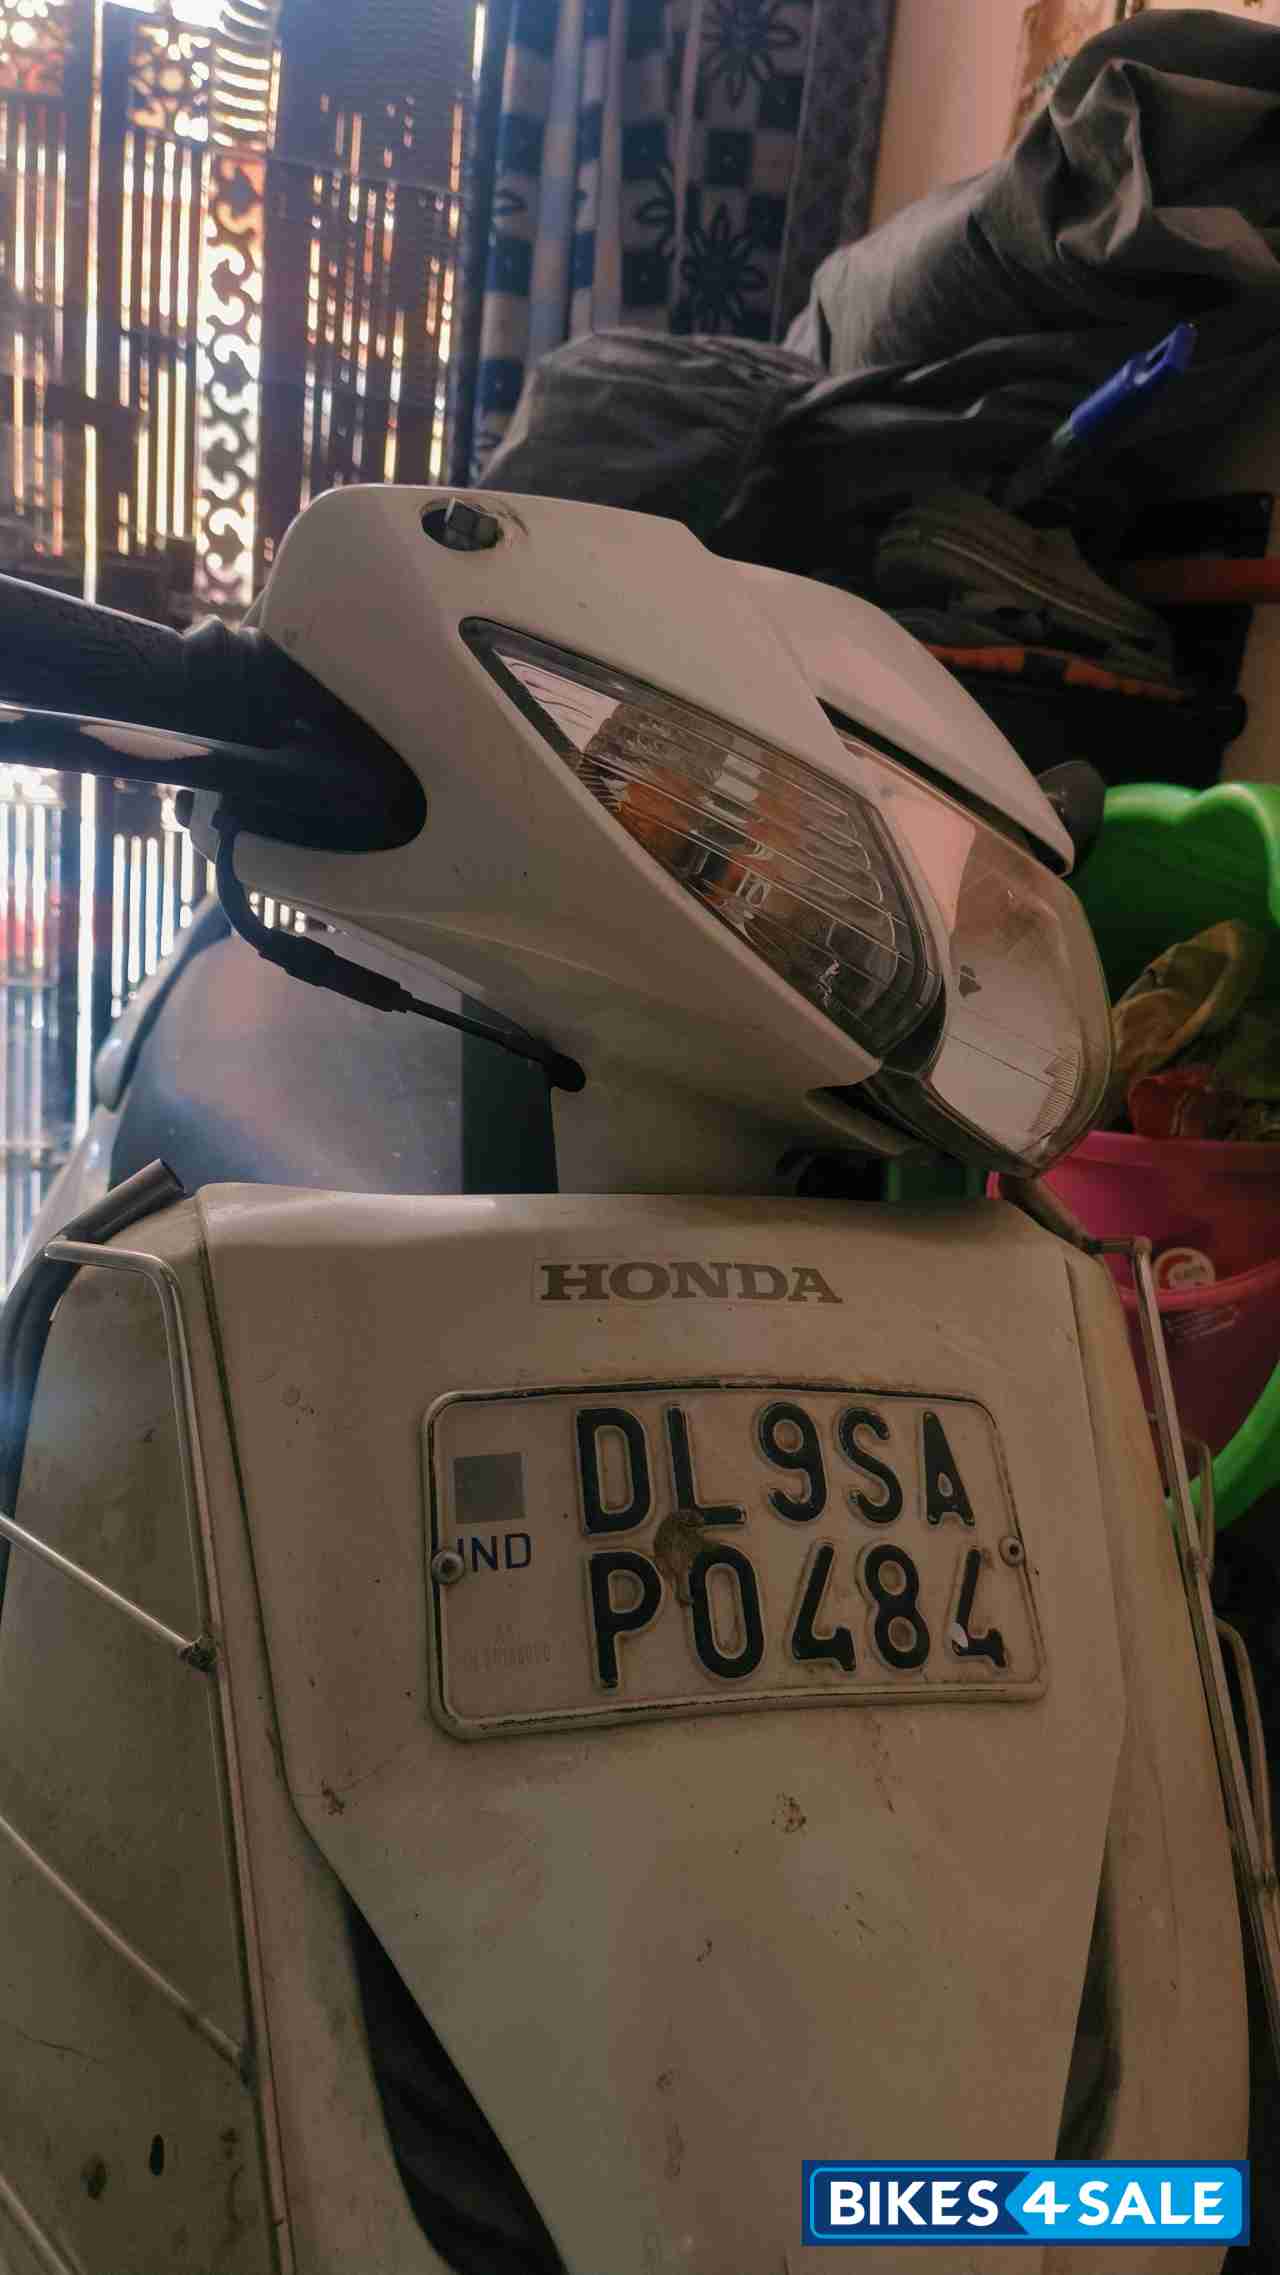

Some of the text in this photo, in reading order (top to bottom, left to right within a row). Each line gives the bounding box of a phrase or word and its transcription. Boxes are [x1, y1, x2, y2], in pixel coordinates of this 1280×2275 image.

[539, 1260, 843, 1303] HONDA
[576, 1402, 976, 1535] DL9SA
[456, 1532, 531, 1572] IND
